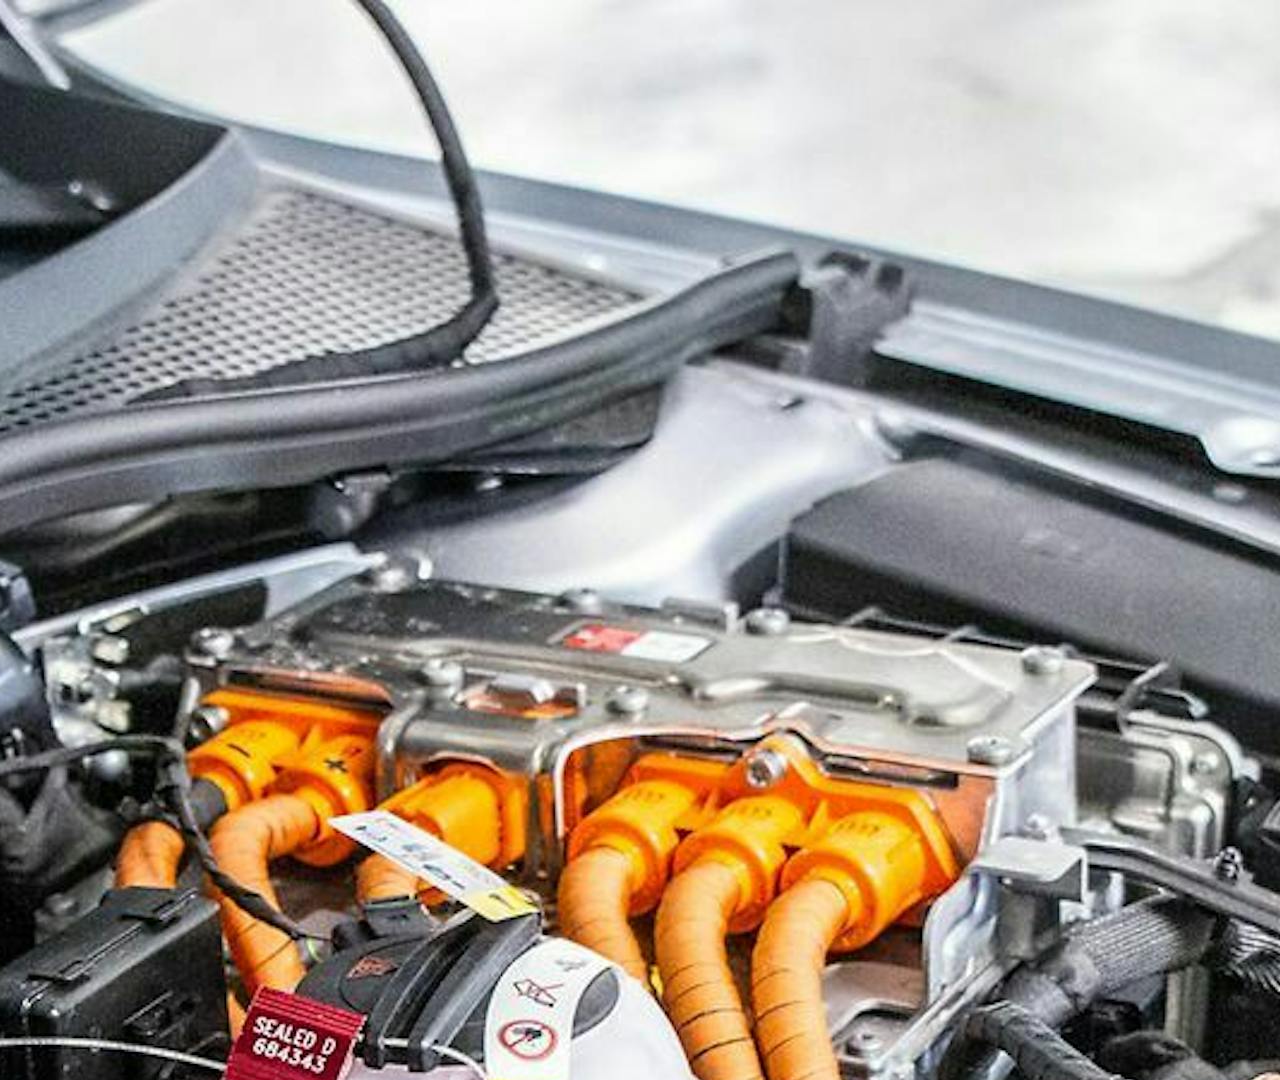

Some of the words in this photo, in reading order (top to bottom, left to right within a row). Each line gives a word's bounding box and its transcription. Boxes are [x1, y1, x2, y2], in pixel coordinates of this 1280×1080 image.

[252, 1016, 317, 1050] SEALED
[321, 1037, 336, 1056] D
[252, 1038, 326, 1074] 684343
